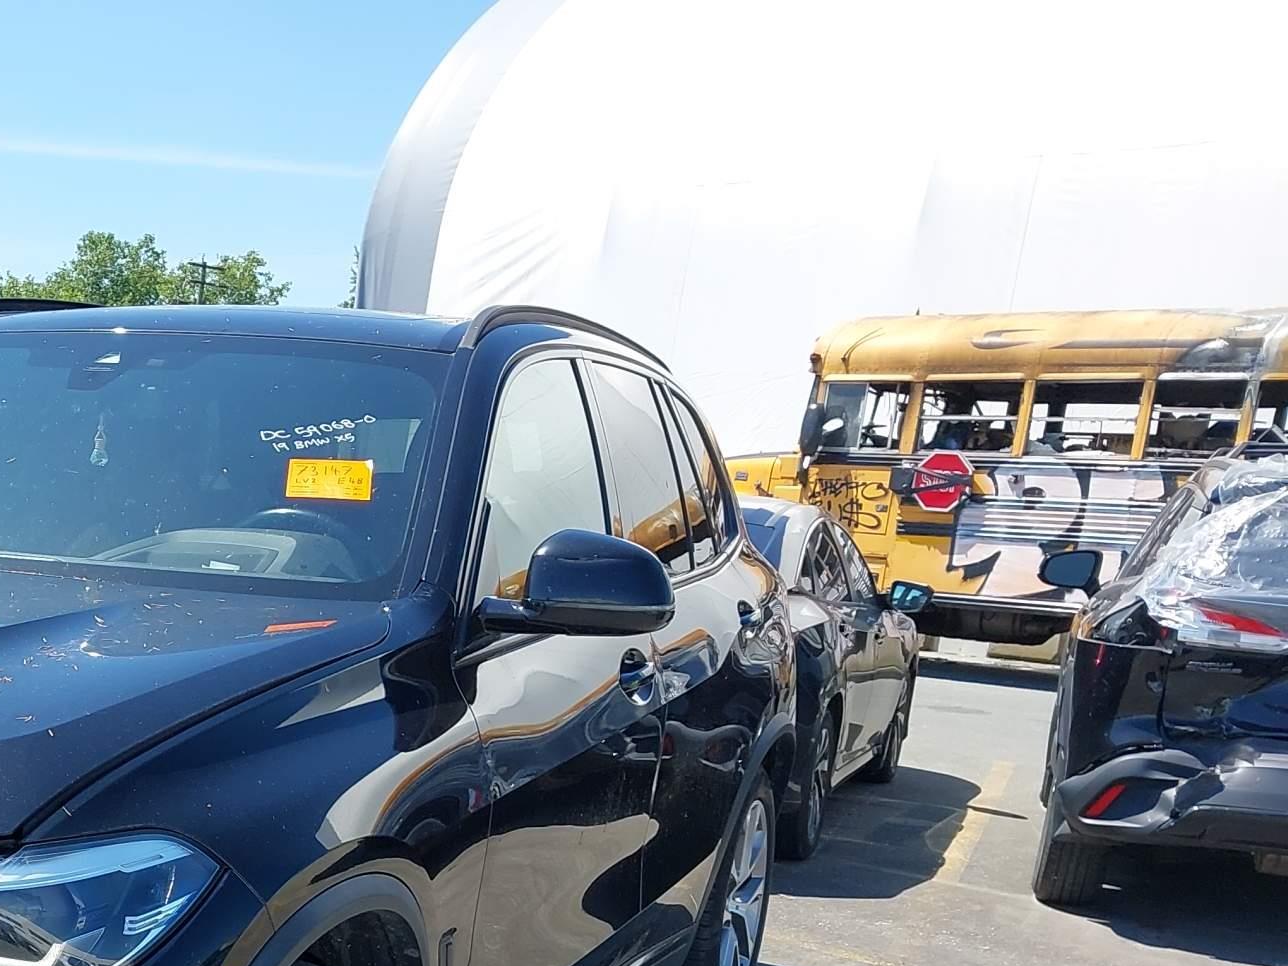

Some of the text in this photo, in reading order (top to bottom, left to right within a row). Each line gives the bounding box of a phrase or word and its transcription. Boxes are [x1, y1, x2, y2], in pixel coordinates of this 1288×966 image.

[259, 430, 291, 441] DC
[272, 441, 290, 453] 19
[294, 437, 330, 450] BMW
